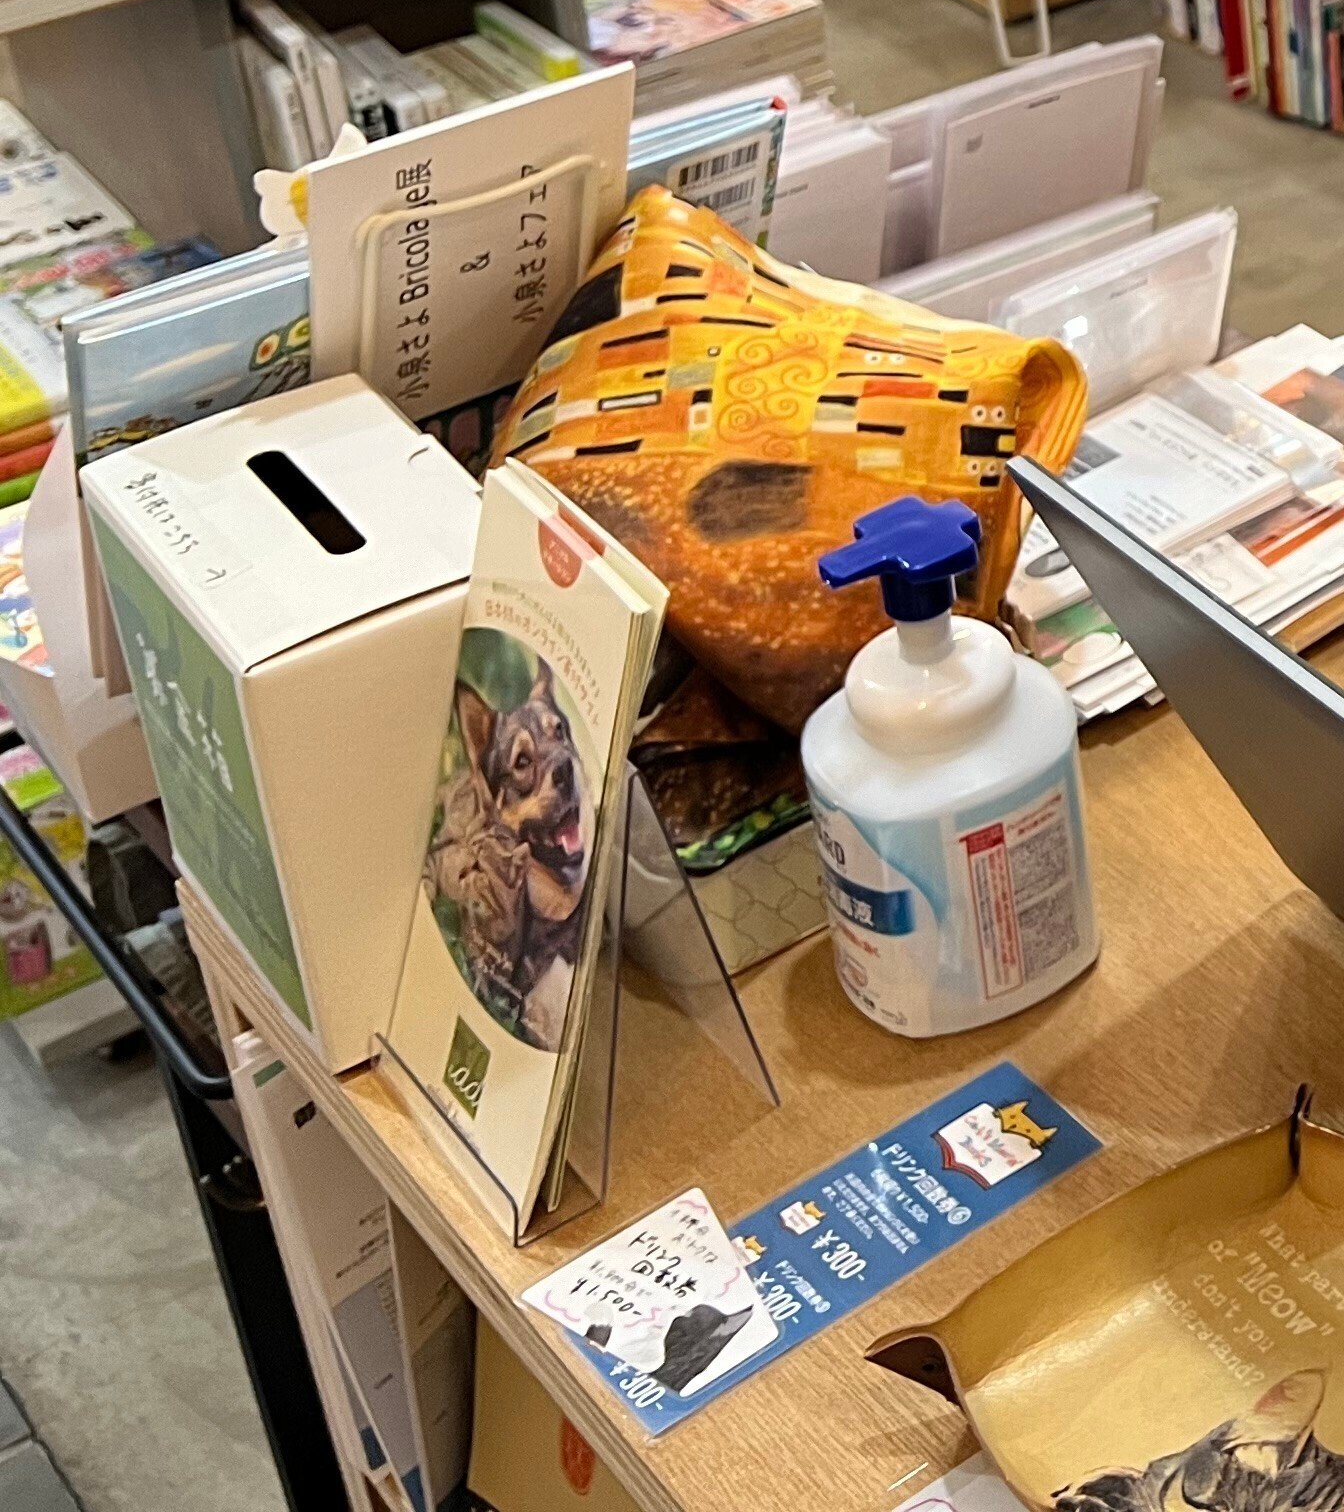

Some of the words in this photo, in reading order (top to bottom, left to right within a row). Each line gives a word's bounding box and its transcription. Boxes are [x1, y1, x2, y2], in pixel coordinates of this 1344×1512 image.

[459, 251, 491, 274] &
[812, 1229, 866, 1282] ¥300-
[1232, 1320, 1275, 1353] you
